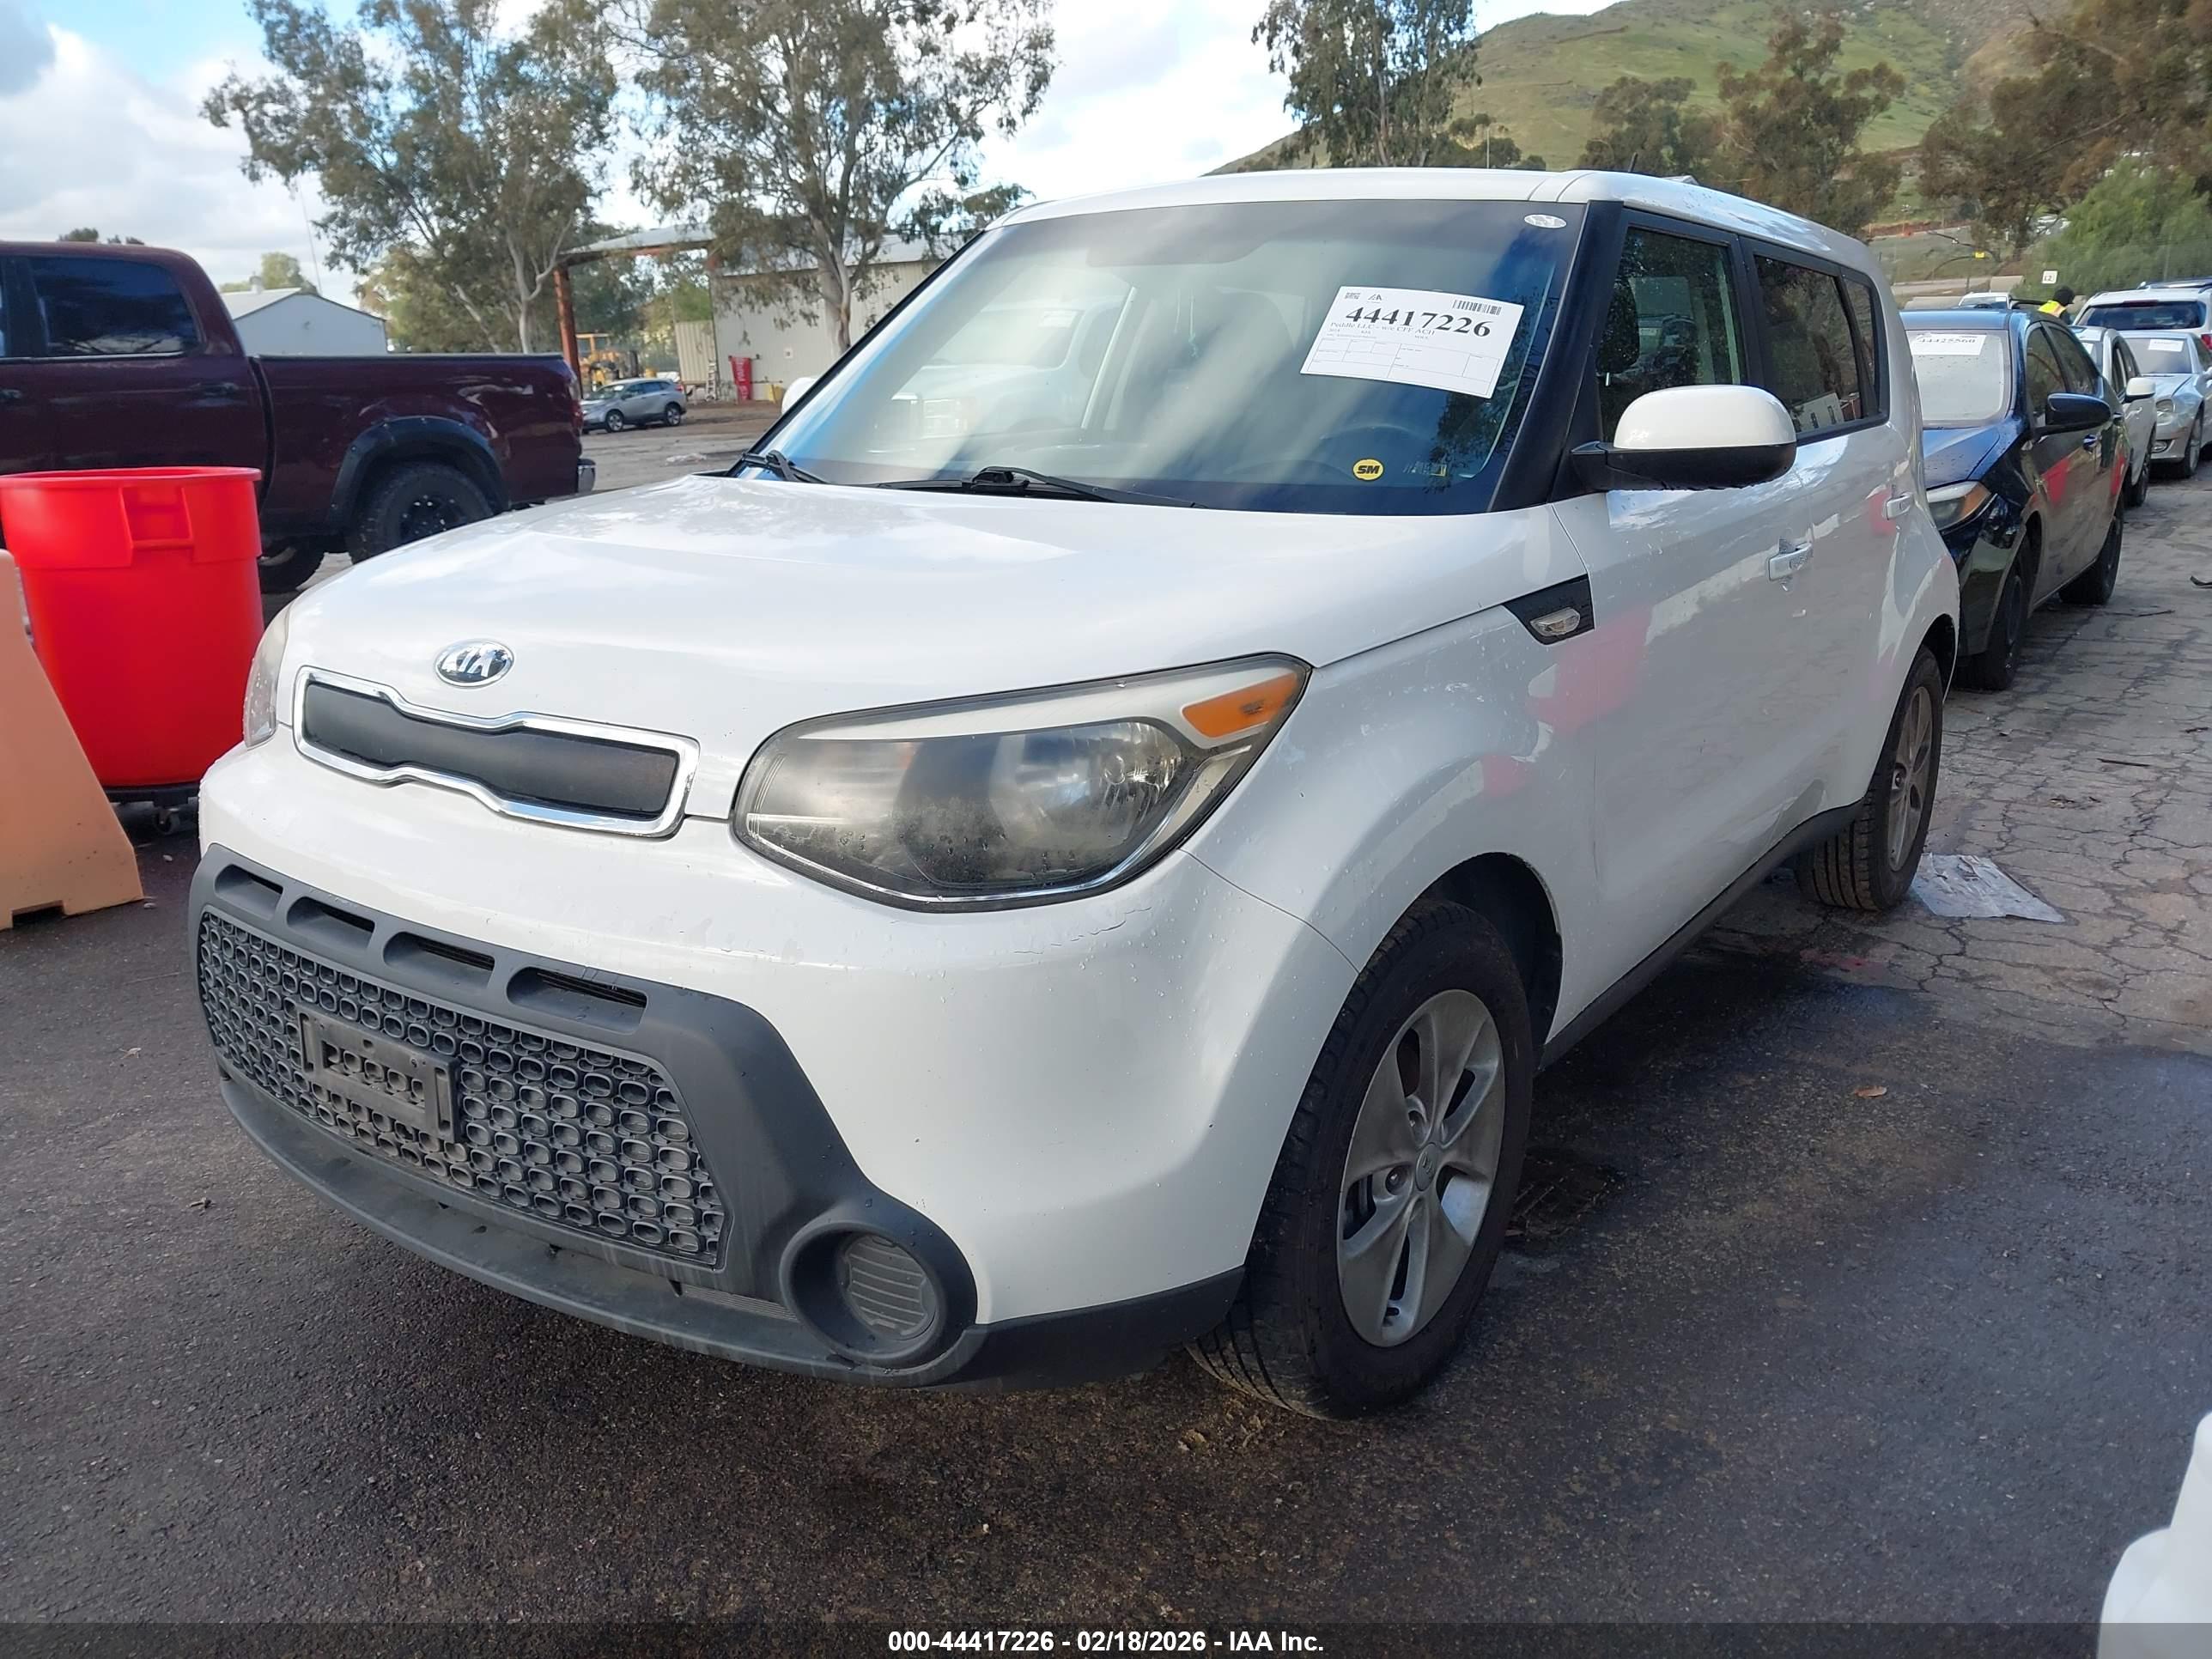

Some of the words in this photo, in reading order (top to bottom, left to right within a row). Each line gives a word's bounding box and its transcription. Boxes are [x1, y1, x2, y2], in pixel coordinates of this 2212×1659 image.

[1346, 307, 1493, 337] 44417226
[1357, 465, 1381, 475] SM
[440, 645, 500, 678] KIA
